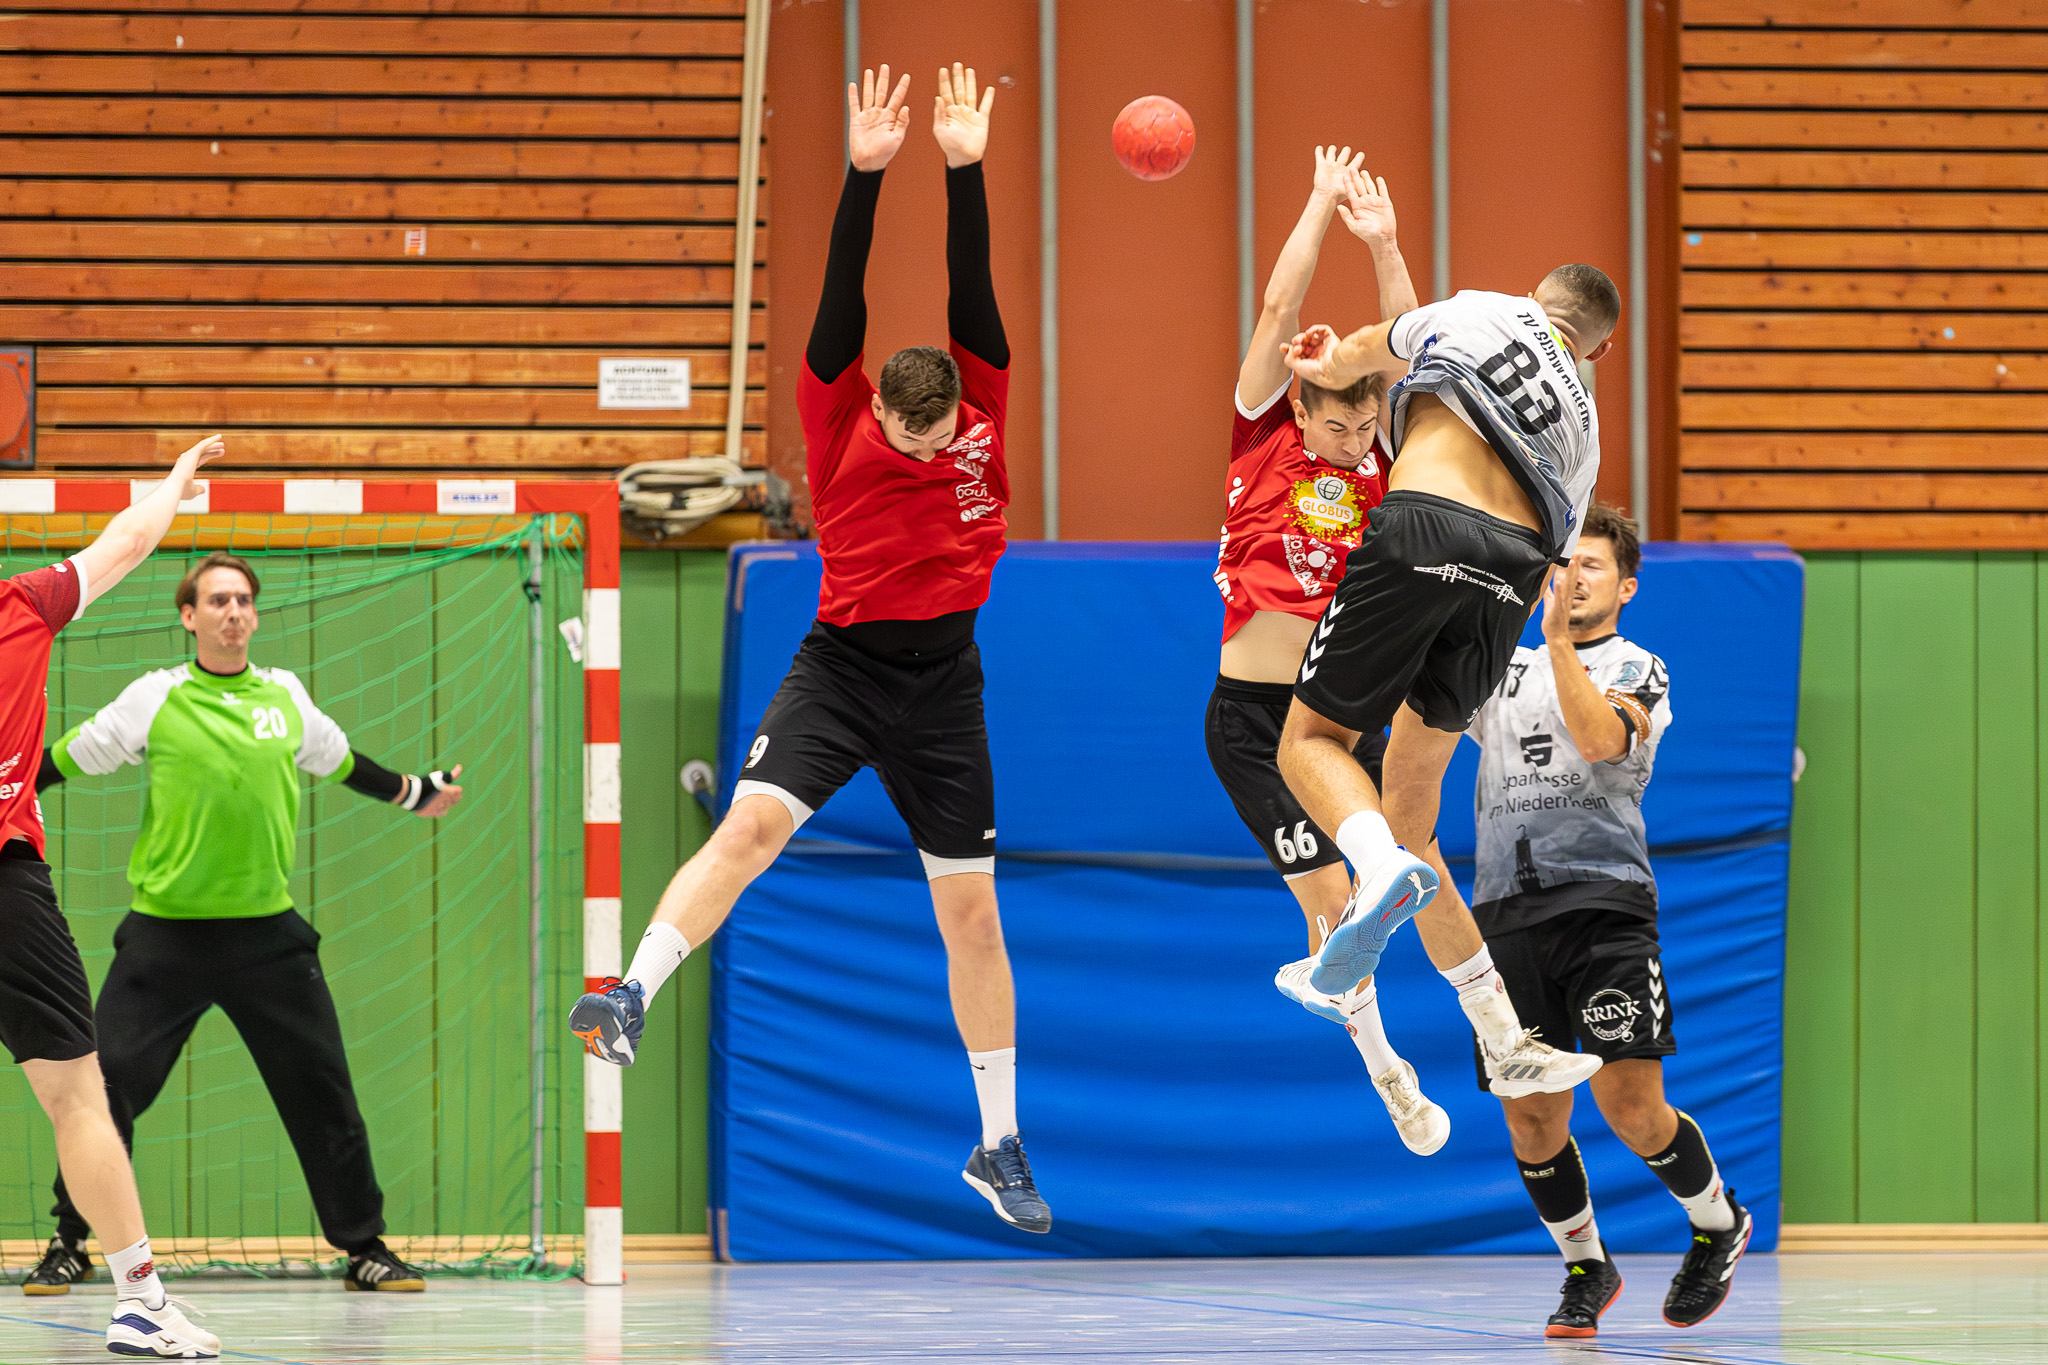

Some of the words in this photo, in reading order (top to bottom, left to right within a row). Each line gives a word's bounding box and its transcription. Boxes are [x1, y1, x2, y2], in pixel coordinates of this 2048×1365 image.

[1516, 311, 1540, 328] TV
[1475, 338, 1562, 436] 83
[1301, 500, 1351, 521] GLOBUS
[1313, 518, 1338, 531] Wesel
[251, 706, 289, 740] 20
[744, 734, 770, 769] 9
[1274, 819, 1319, 864] 66
[1581, 1000, 1643, 1024] KRINK
[1523, 1166, 1555, 1178] SELECT
